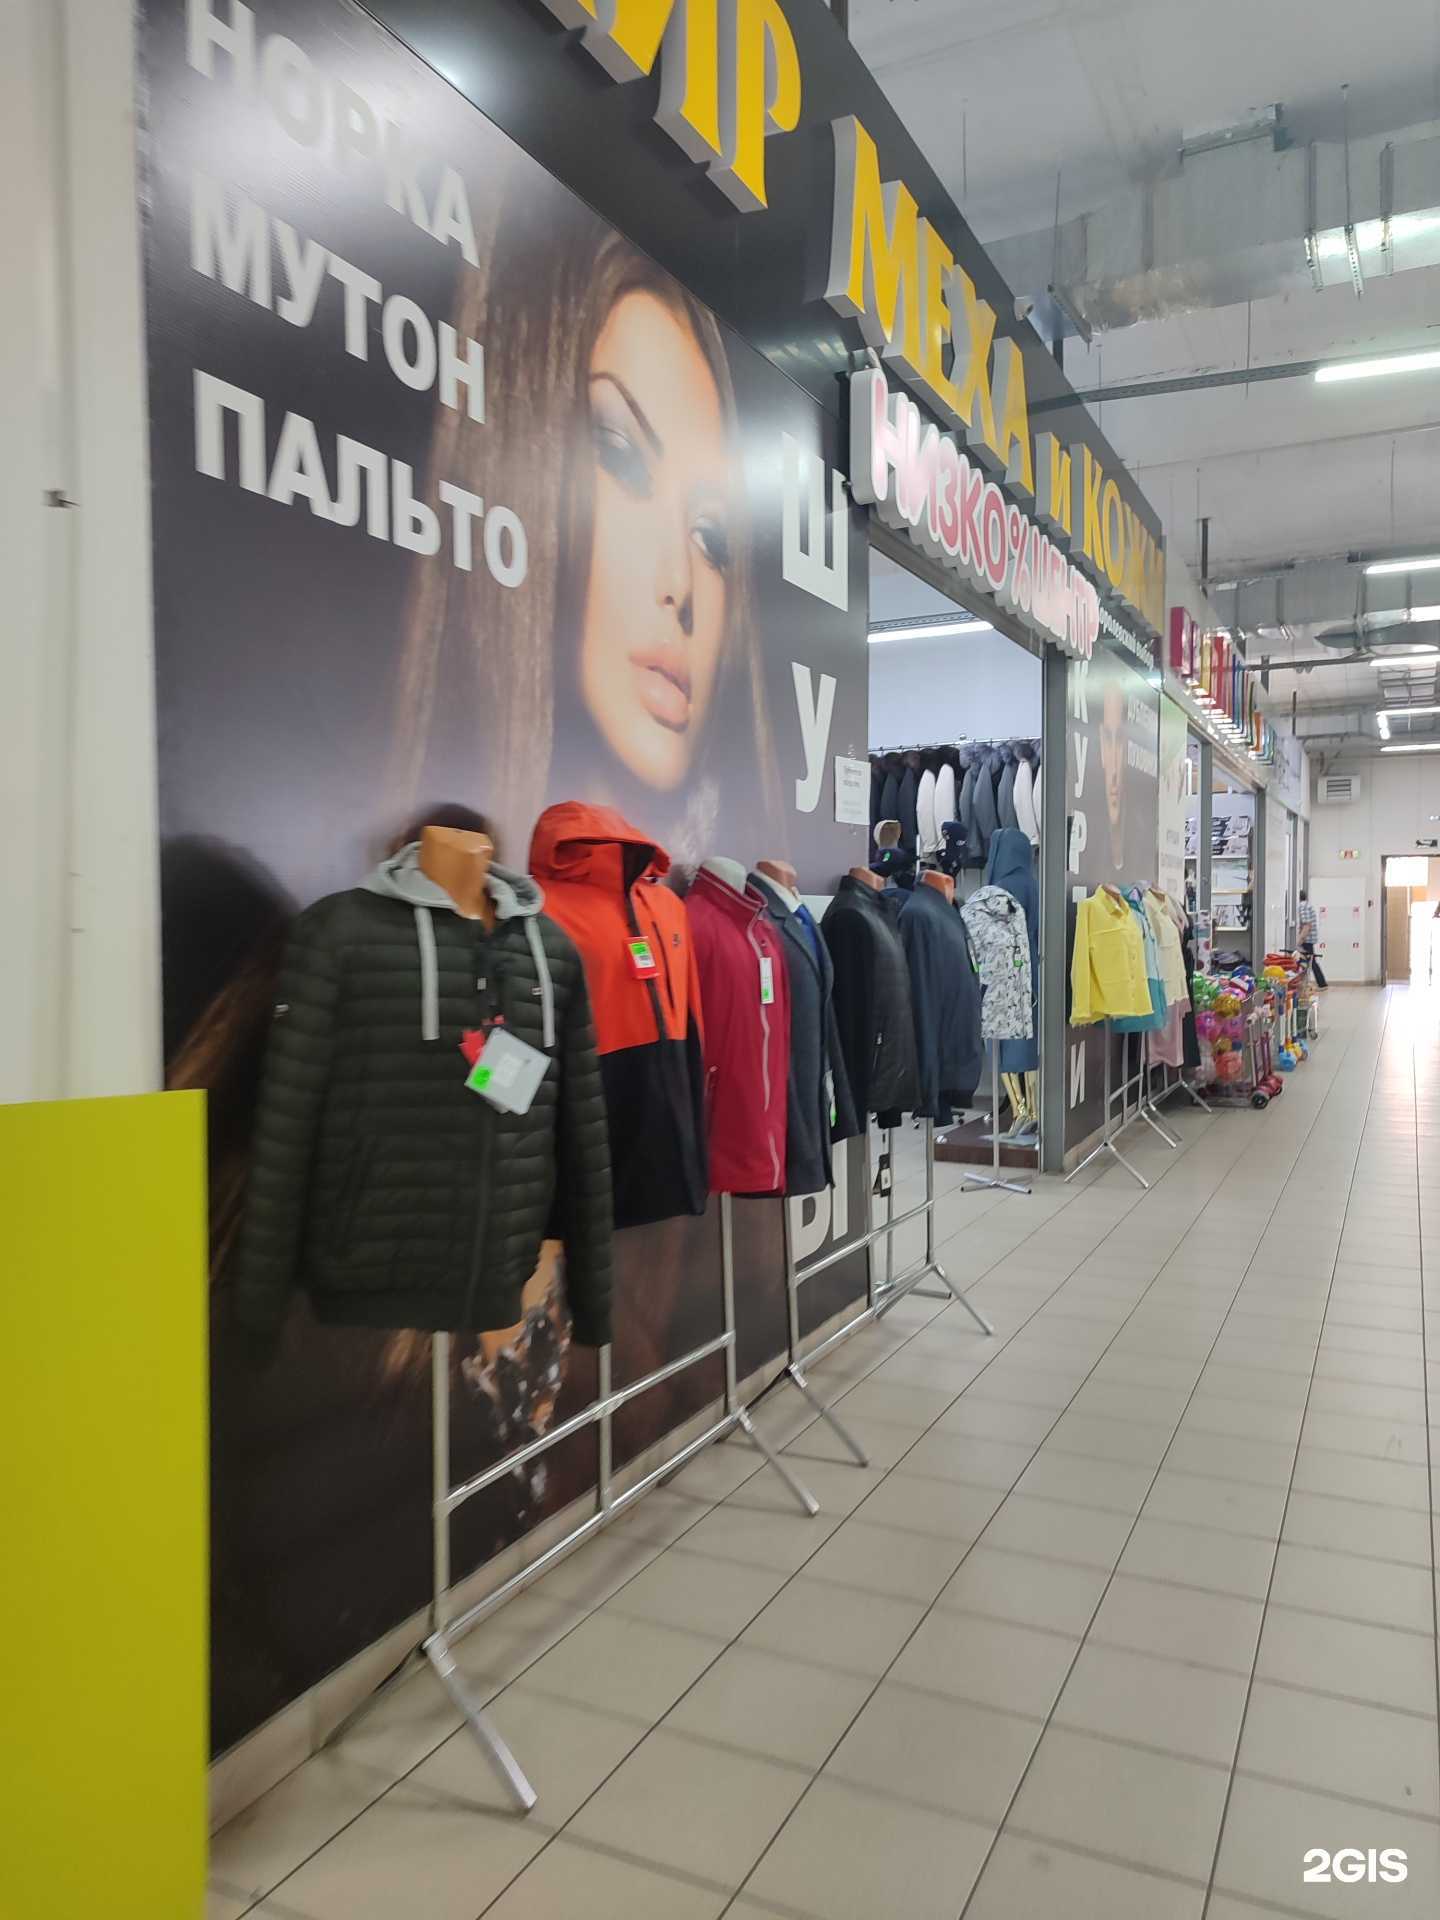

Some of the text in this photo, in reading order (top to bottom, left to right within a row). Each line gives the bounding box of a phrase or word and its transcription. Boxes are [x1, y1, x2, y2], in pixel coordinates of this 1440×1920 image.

[186, 0, 480, 269] НОРКА
[188, 169, 486, 424] МУТОН
[826, 114, 1034, 498] МЕХА
[1074, 443, 1165, 636] КОЖИ
[193, 369, 529, 589] ПАЛЬТО
